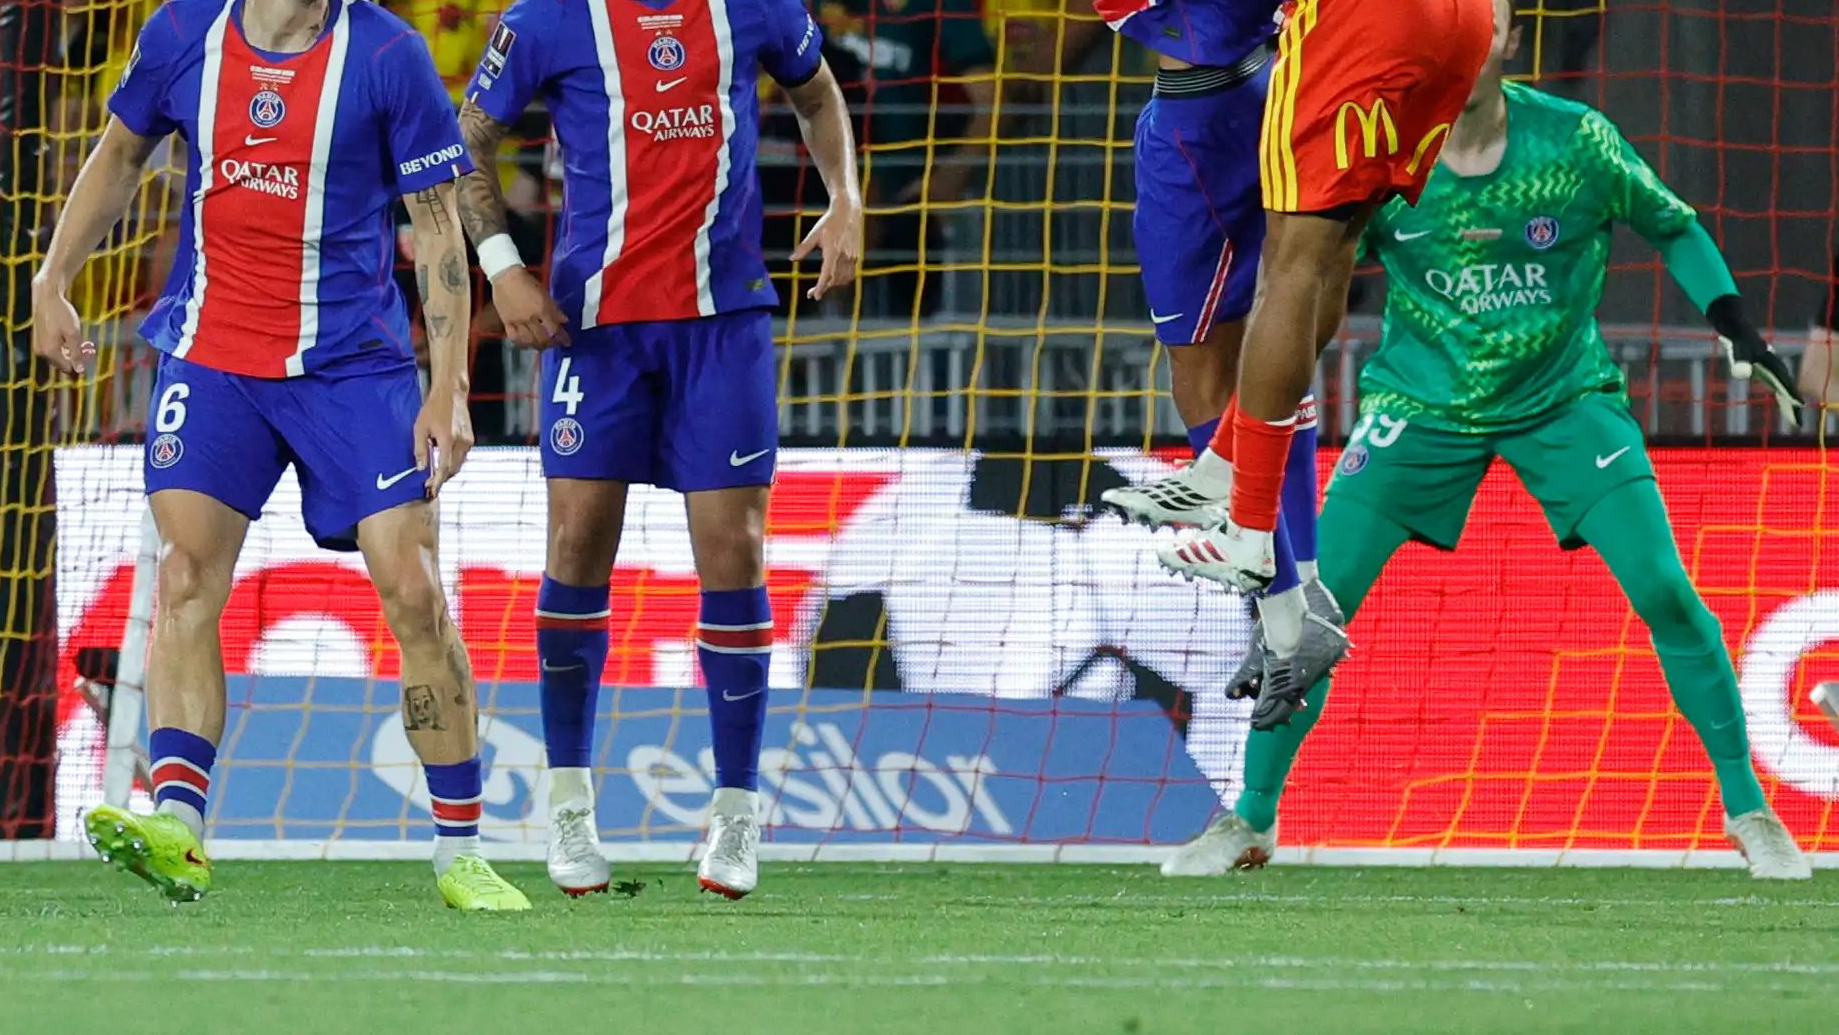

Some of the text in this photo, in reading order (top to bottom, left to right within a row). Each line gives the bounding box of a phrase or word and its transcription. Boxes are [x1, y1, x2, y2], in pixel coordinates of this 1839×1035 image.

[631, 104, 714, 130] QATAR
[654, 124, 715, 143] AIRWAYS
[221, 159, 300, 187] QATAR
[399, 143, 463, 177] BEYOND
[240, 177, 299, 200] AIRWAYS
[1425, 263, 1549, 301] QATAR
[1460, 289, 1552, 315] AIRWAYS
[552, 357, 585, 415] 4
[156, 382, 190, 433] 6
[627, 721, 1014, 834] esilor
